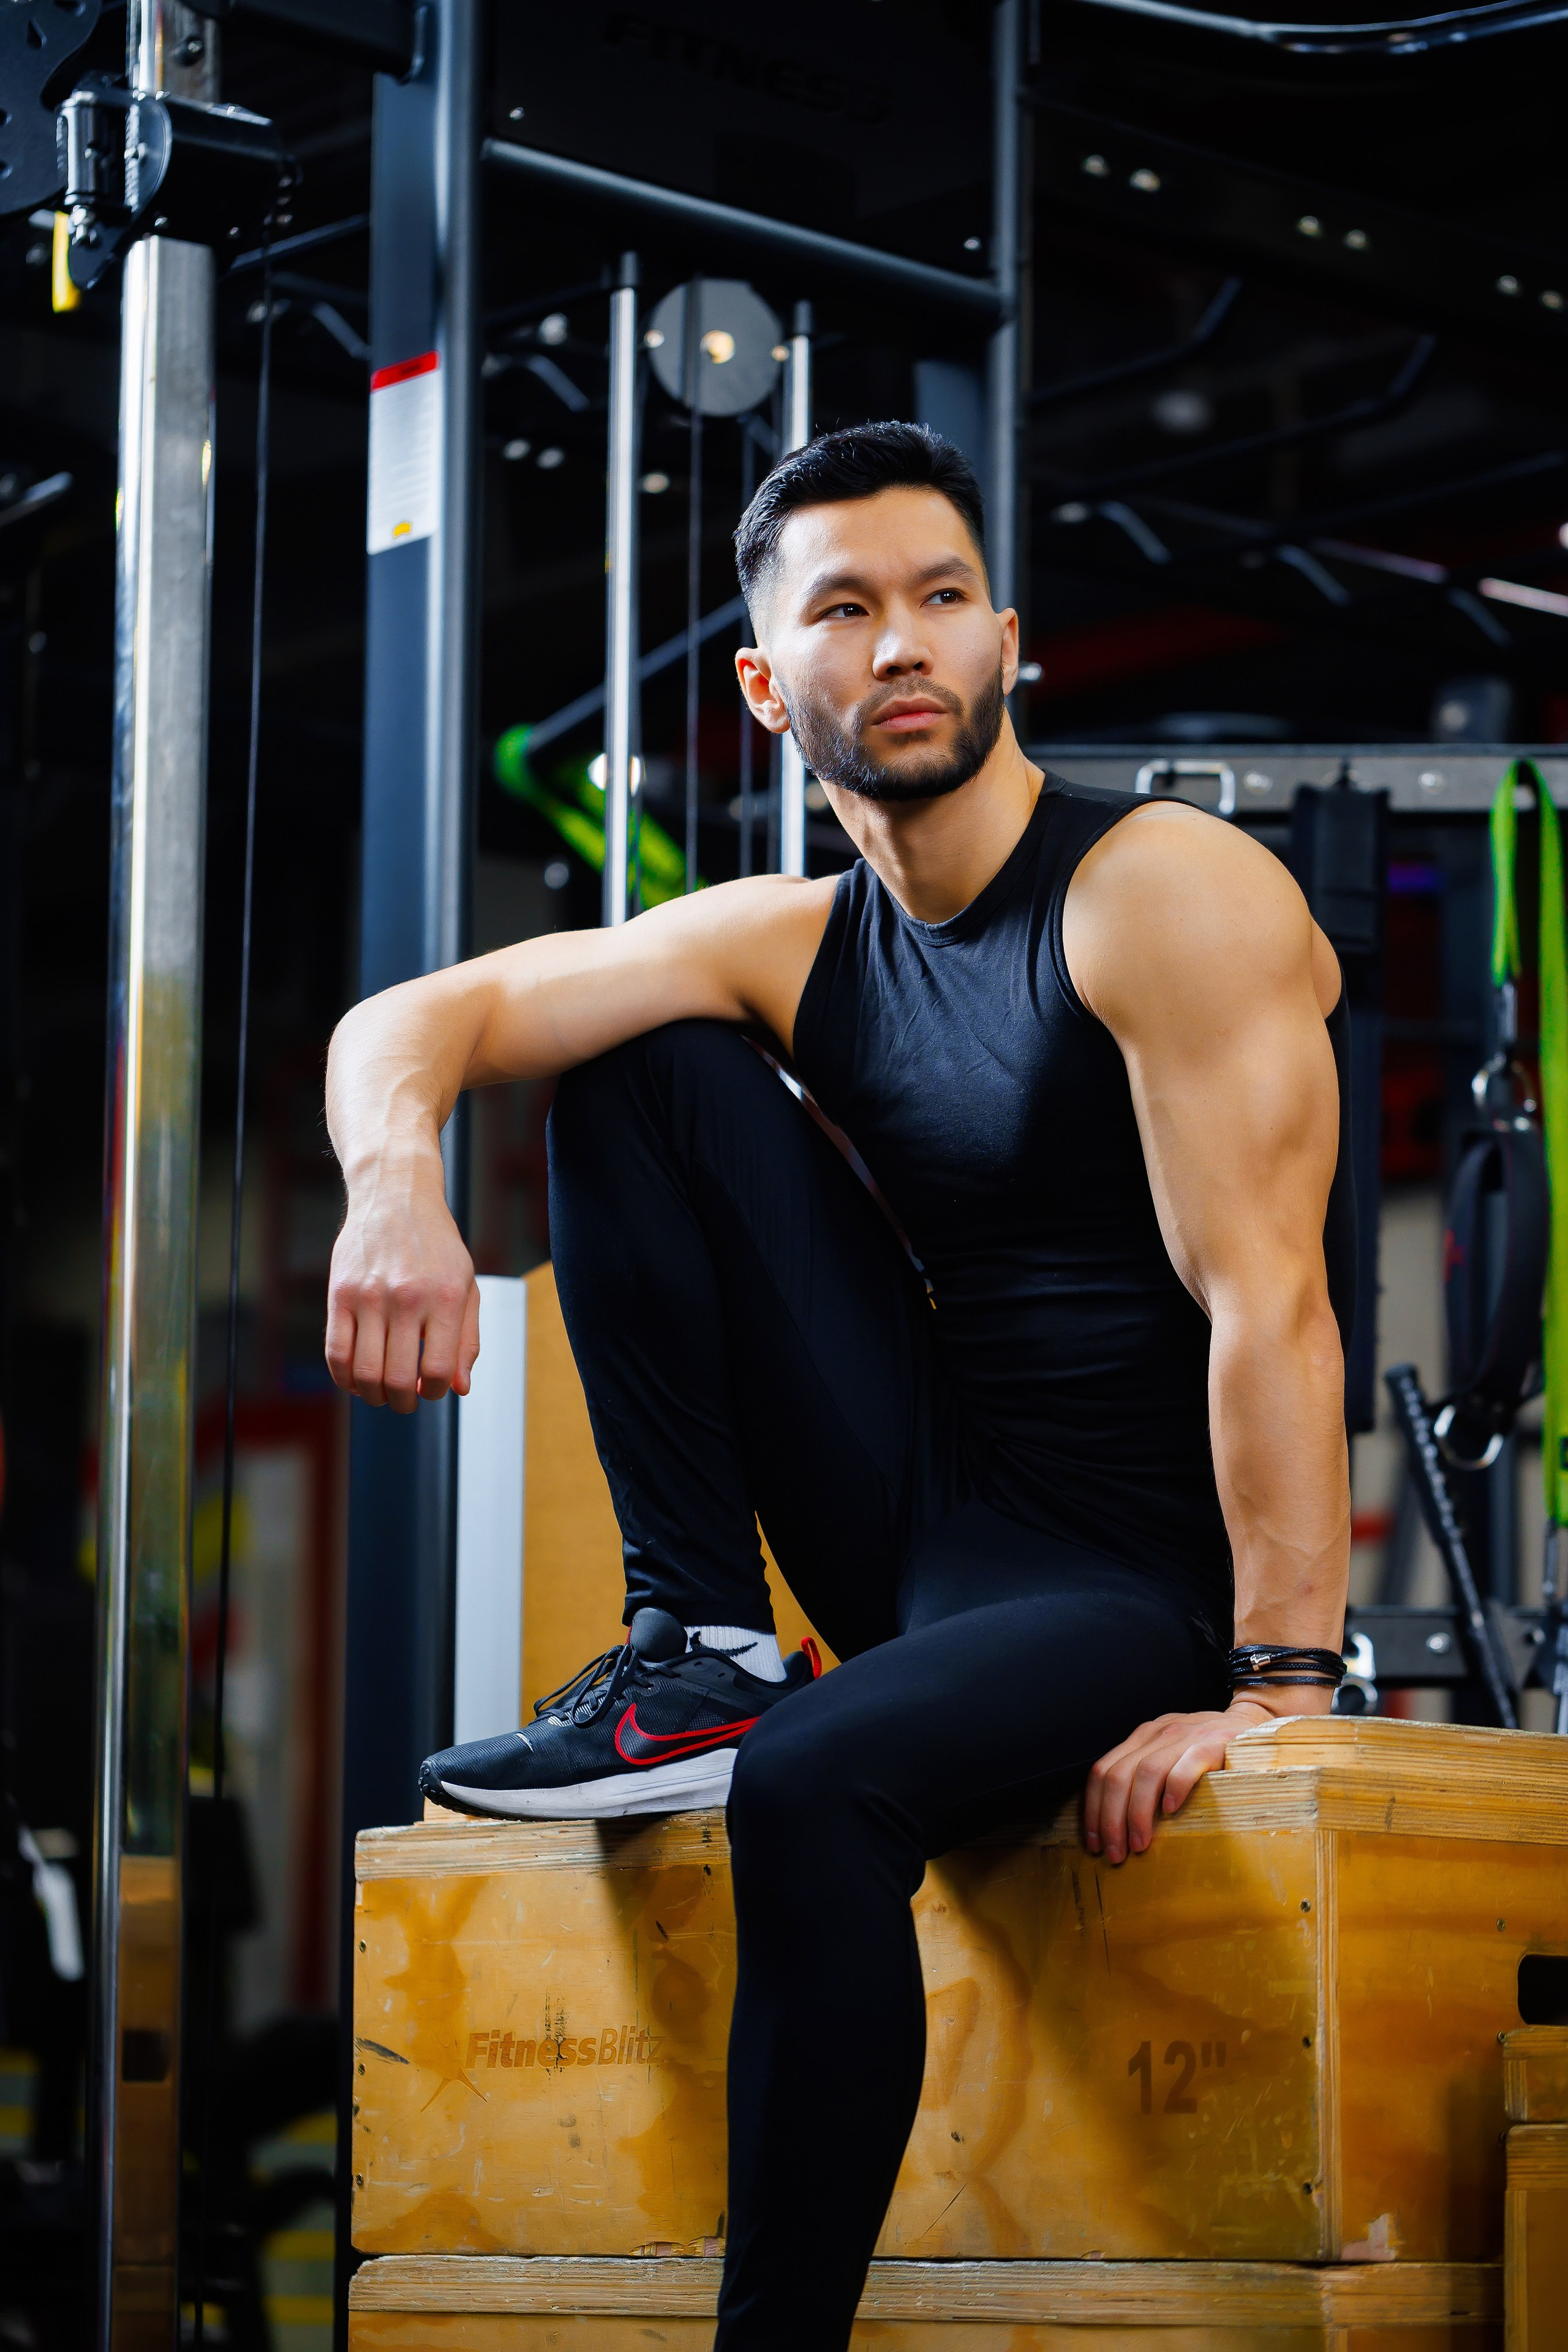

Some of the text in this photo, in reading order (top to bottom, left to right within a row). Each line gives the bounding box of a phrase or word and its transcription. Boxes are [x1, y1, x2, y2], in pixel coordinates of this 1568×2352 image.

[601, 11, 894, 124] FITNESS
[466, 2025, 665, 2069] FitnessBlitz
[1128, 2040, 1227, 2114] 12"
